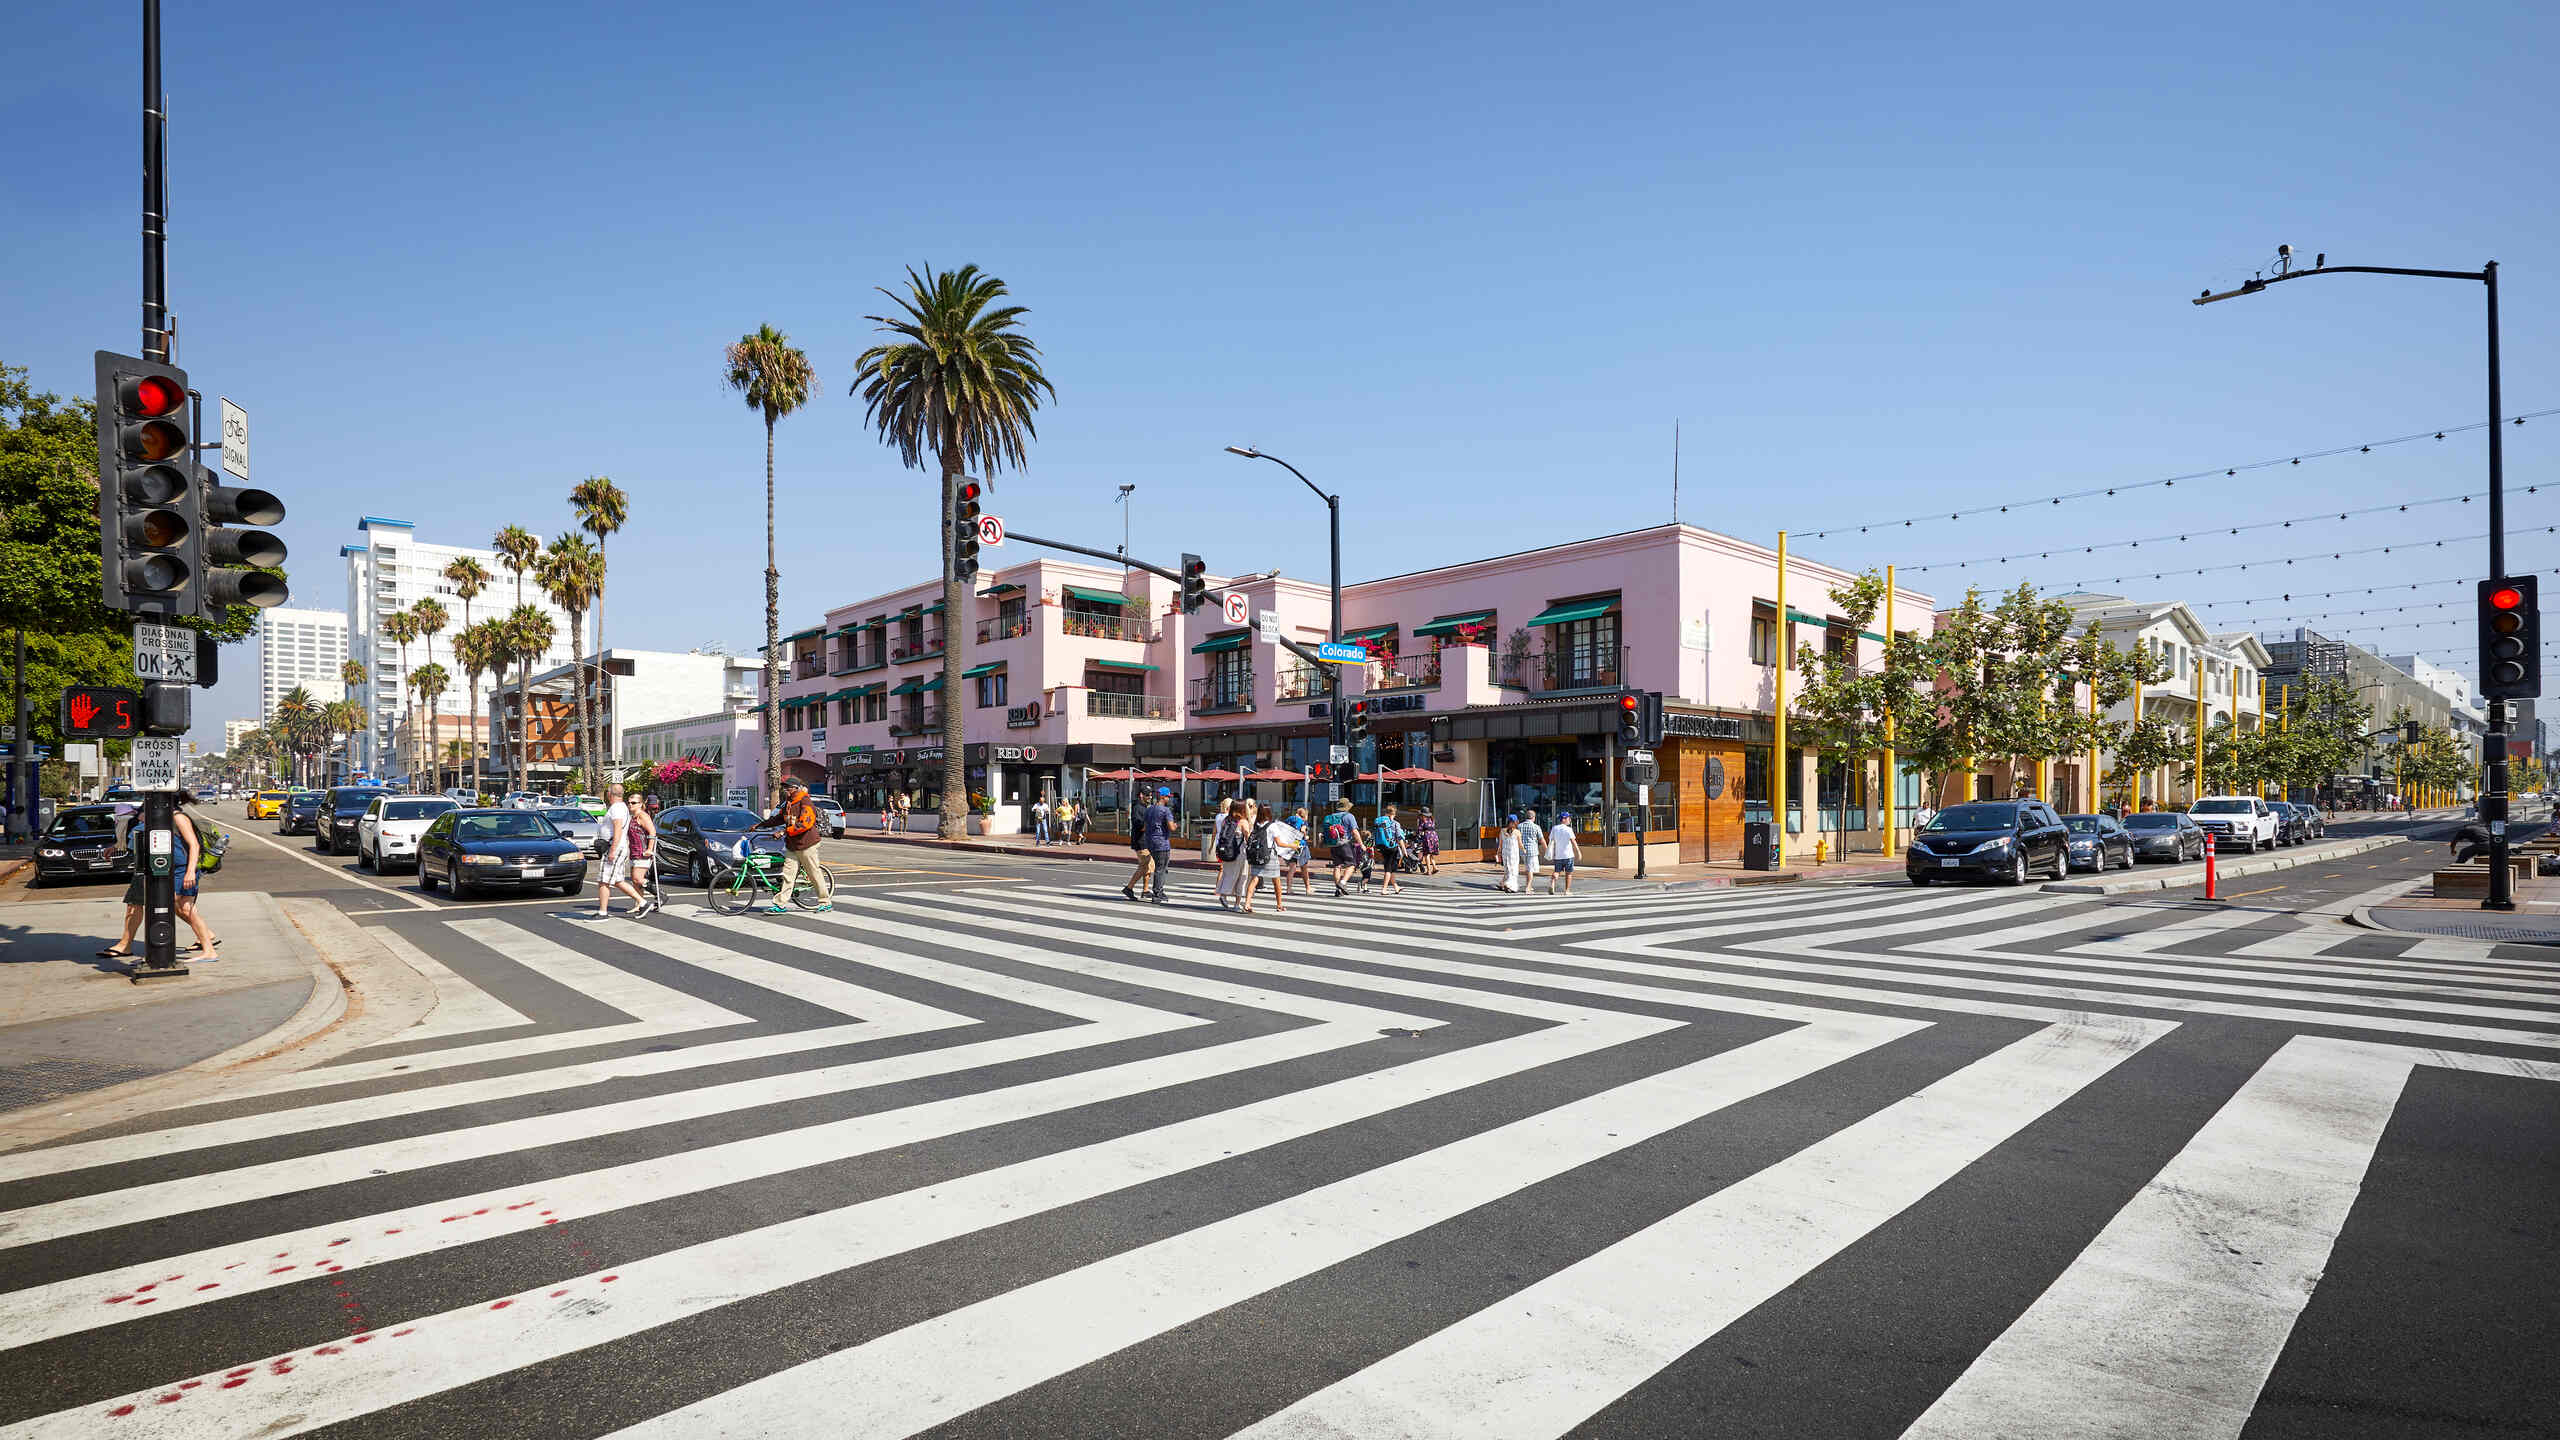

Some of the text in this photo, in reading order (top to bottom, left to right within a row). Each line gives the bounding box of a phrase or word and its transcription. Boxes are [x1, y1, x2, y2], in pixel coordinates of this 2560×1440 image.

[224, 446, 247, 469] SIGNAL
[141, 626, 189, 640] DIAGONAL
[142, 637, 189, 650] CROSSING
[1321, 644, 1364, 659] Colorado
[138, 652, 160, 673] OK
[116, 700, 131, 729] 5
[136, 740, 174, 750] CROSS
[996, 747, 1022, 759] RED
[140, 760, 170, 768] WALK
[136, 769, 176, 778] SIGNAL
